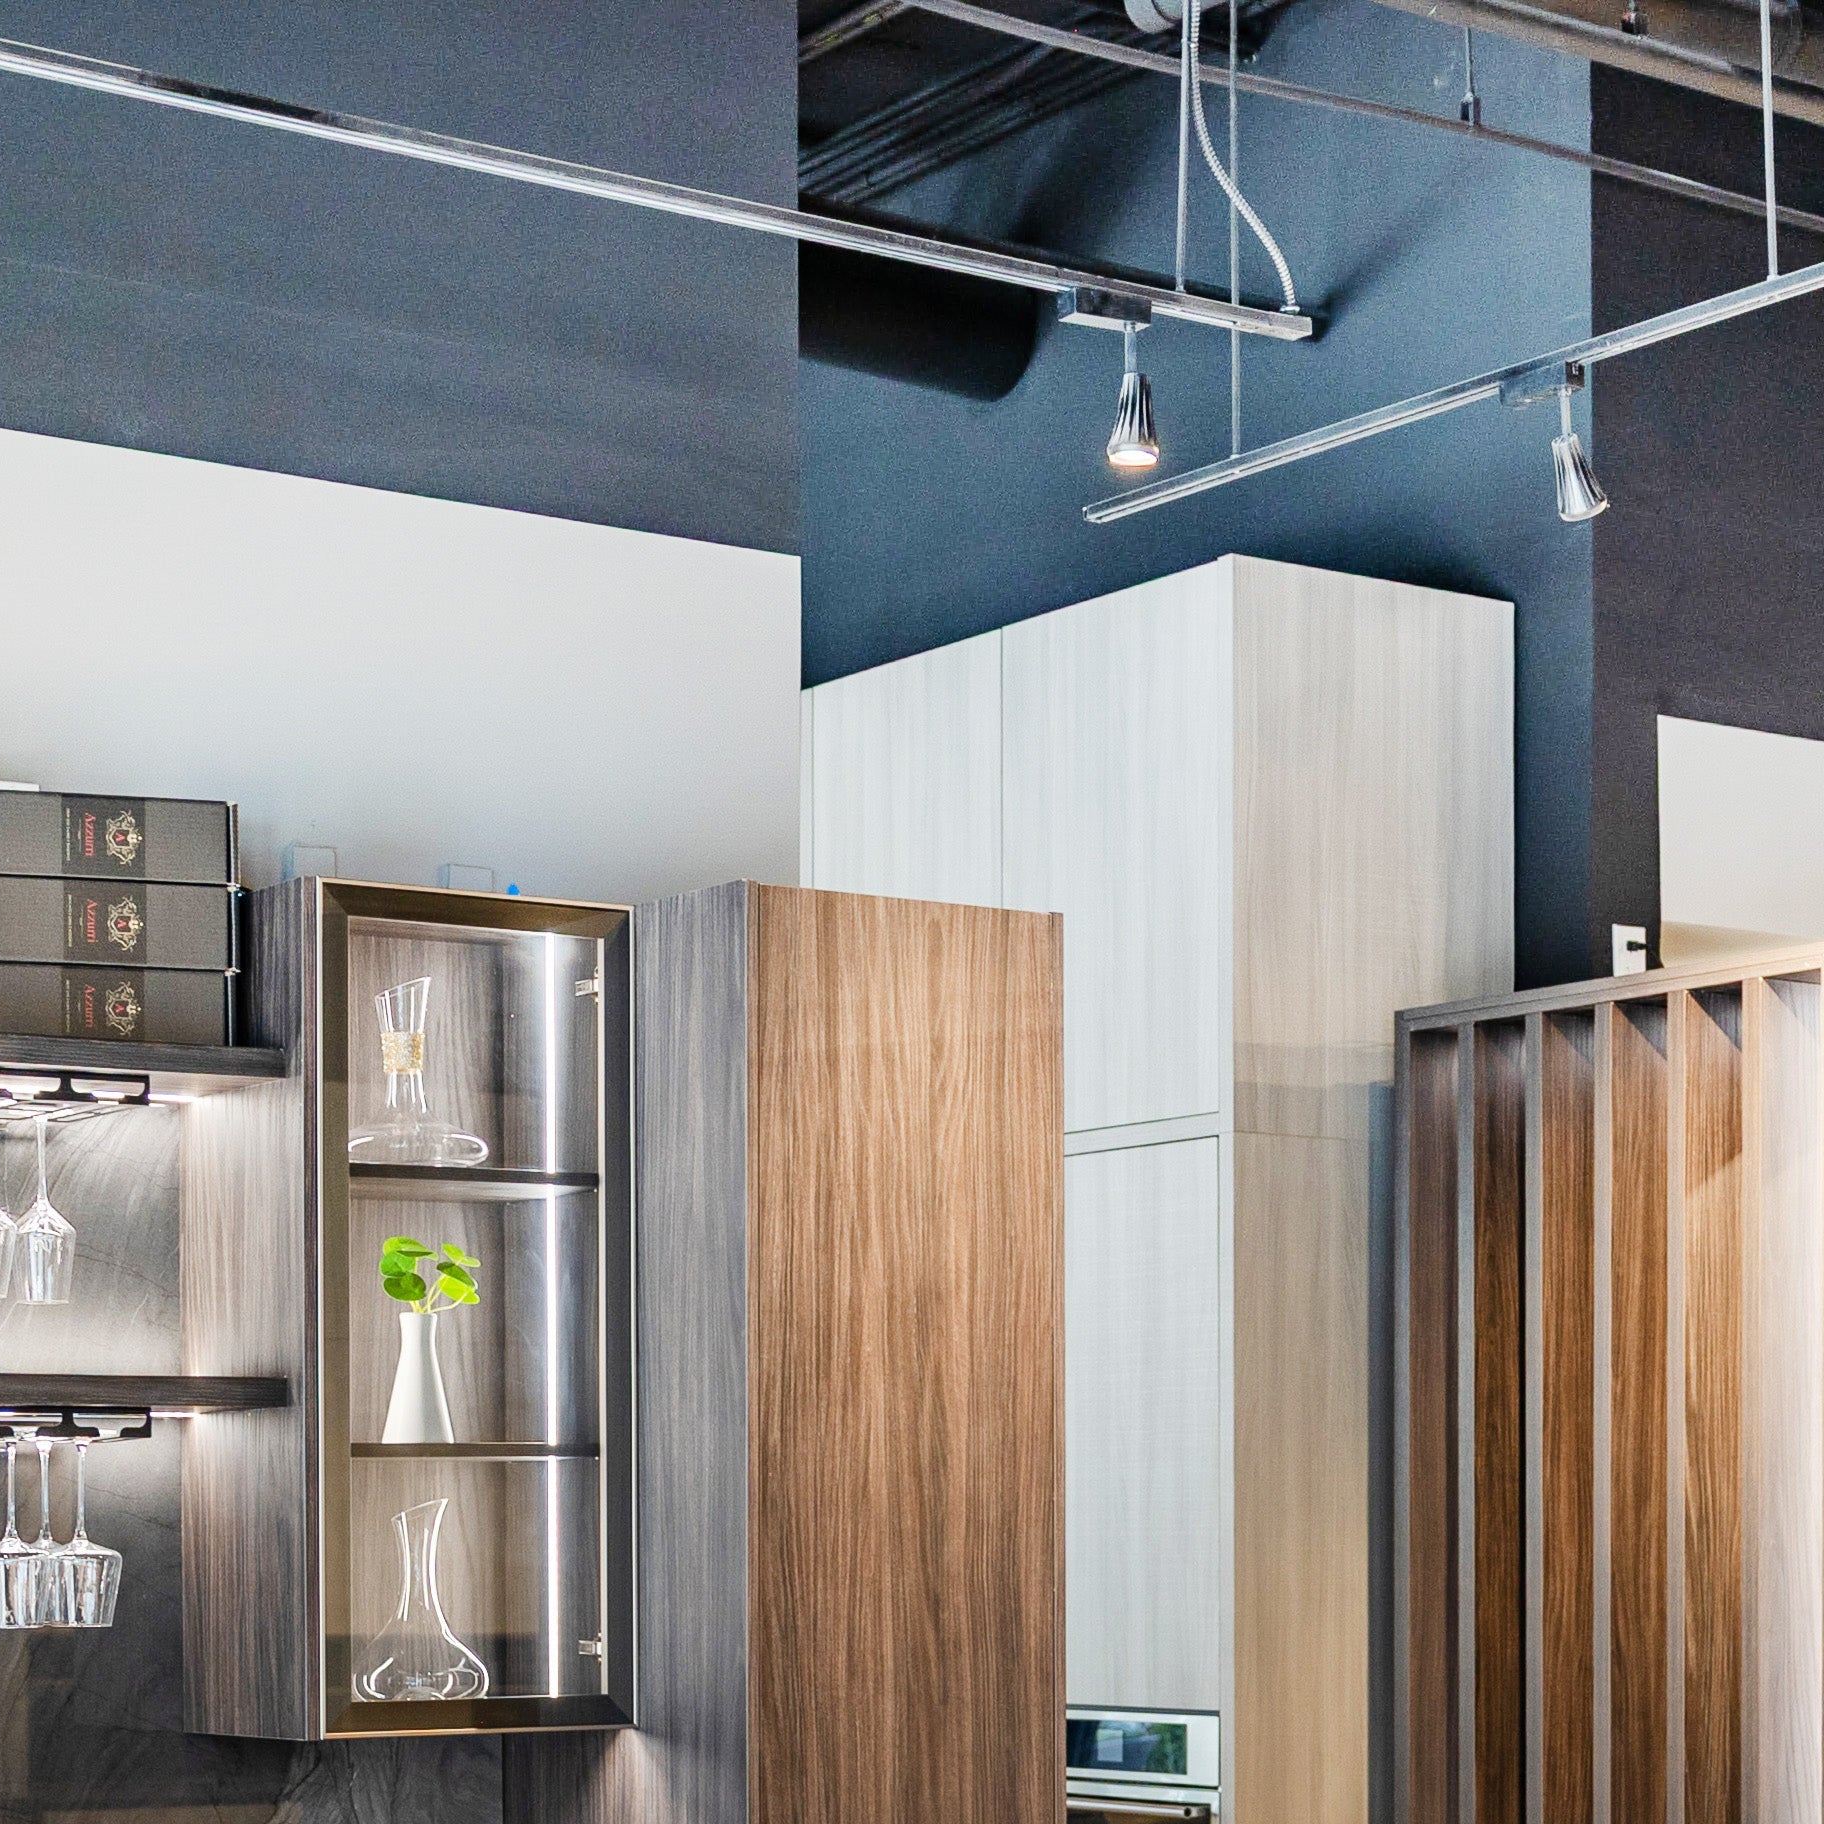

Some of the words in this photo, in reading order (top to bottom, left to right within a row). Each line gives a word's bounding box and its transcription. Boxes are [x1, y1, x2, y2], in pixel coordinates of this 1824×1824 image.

[84, 812, 97, 857] Azzurri
[84, 898, 98, 945] Azzurri
[84, 984, 97, 1029] Azzurri
